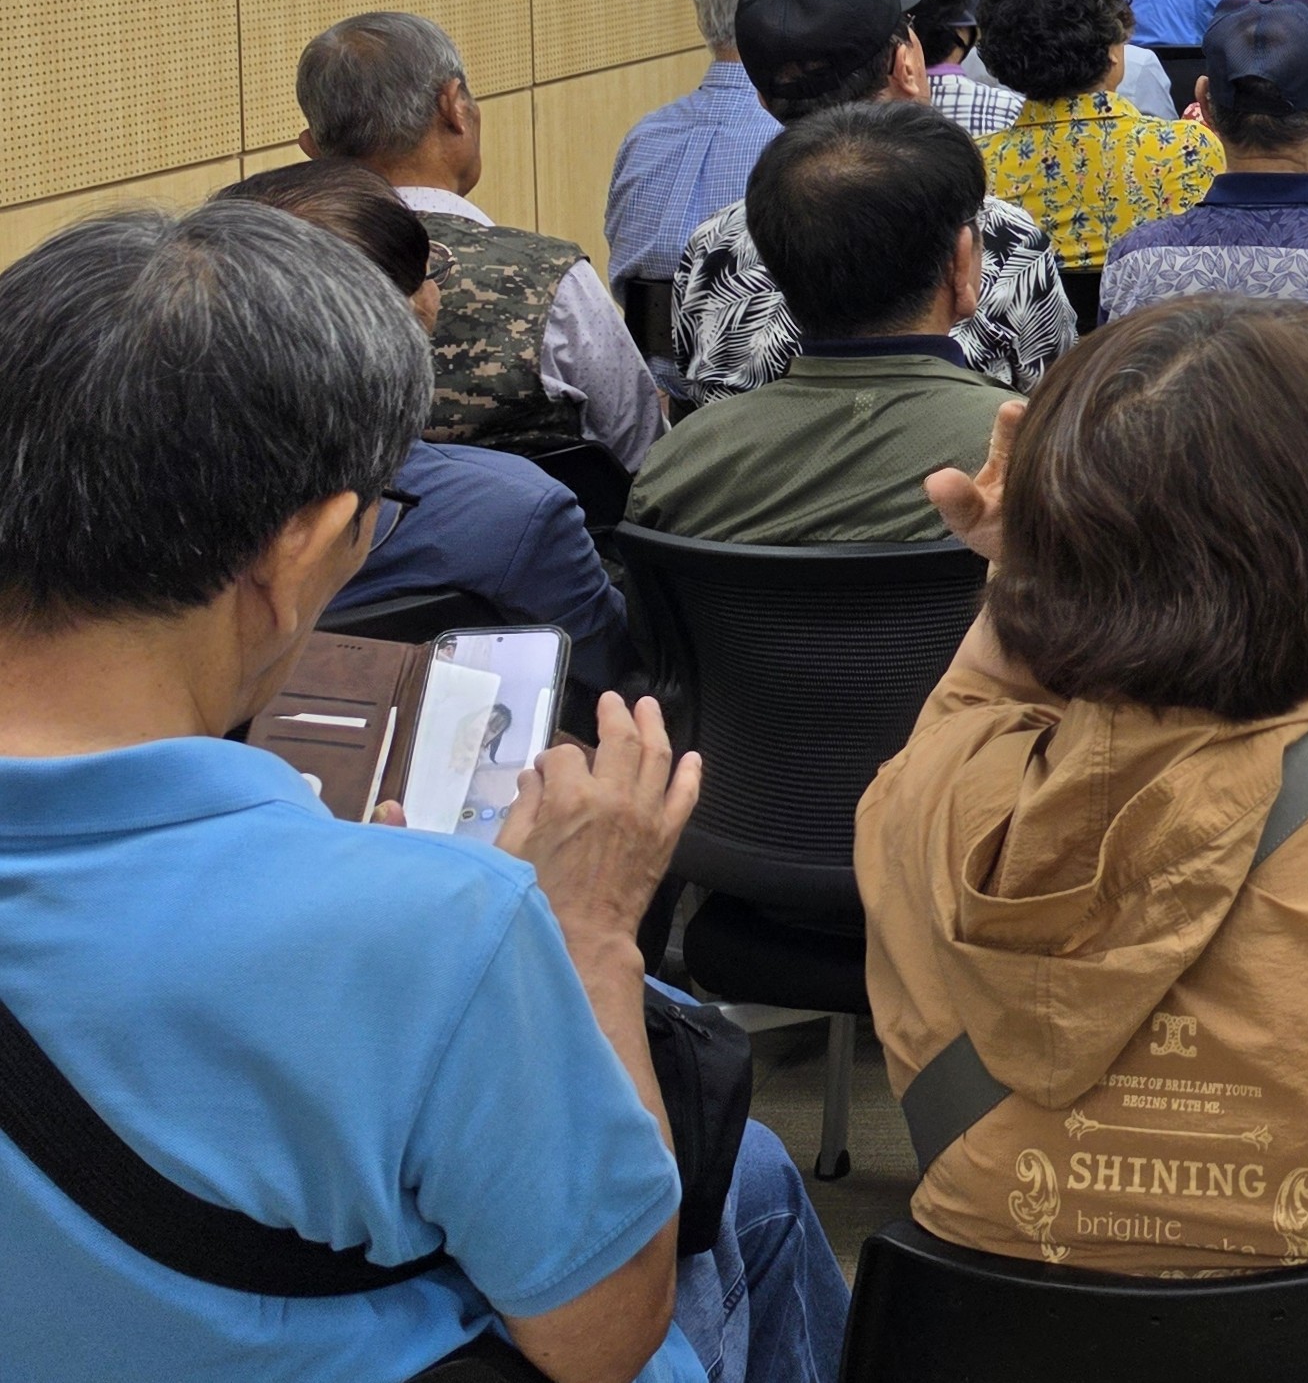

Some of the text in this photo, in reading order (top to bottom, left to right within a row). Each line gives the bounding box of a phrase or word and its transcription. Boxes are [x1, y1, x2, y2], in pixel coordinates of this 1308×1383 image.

[1108, 1074, 1147, 1089] STORY
[1149, 1078, 1164, 1090] OF
[1165, 1079, 1224, 1095] BRILIANT
[1225, 1084, 1262, 1098] YOUTH
[1122, 1094, 1168, 1109] BEGINS
[1171, 1098, 1201, 1112] WITH
[1067, 1151, 1267, 1198] SHINING
